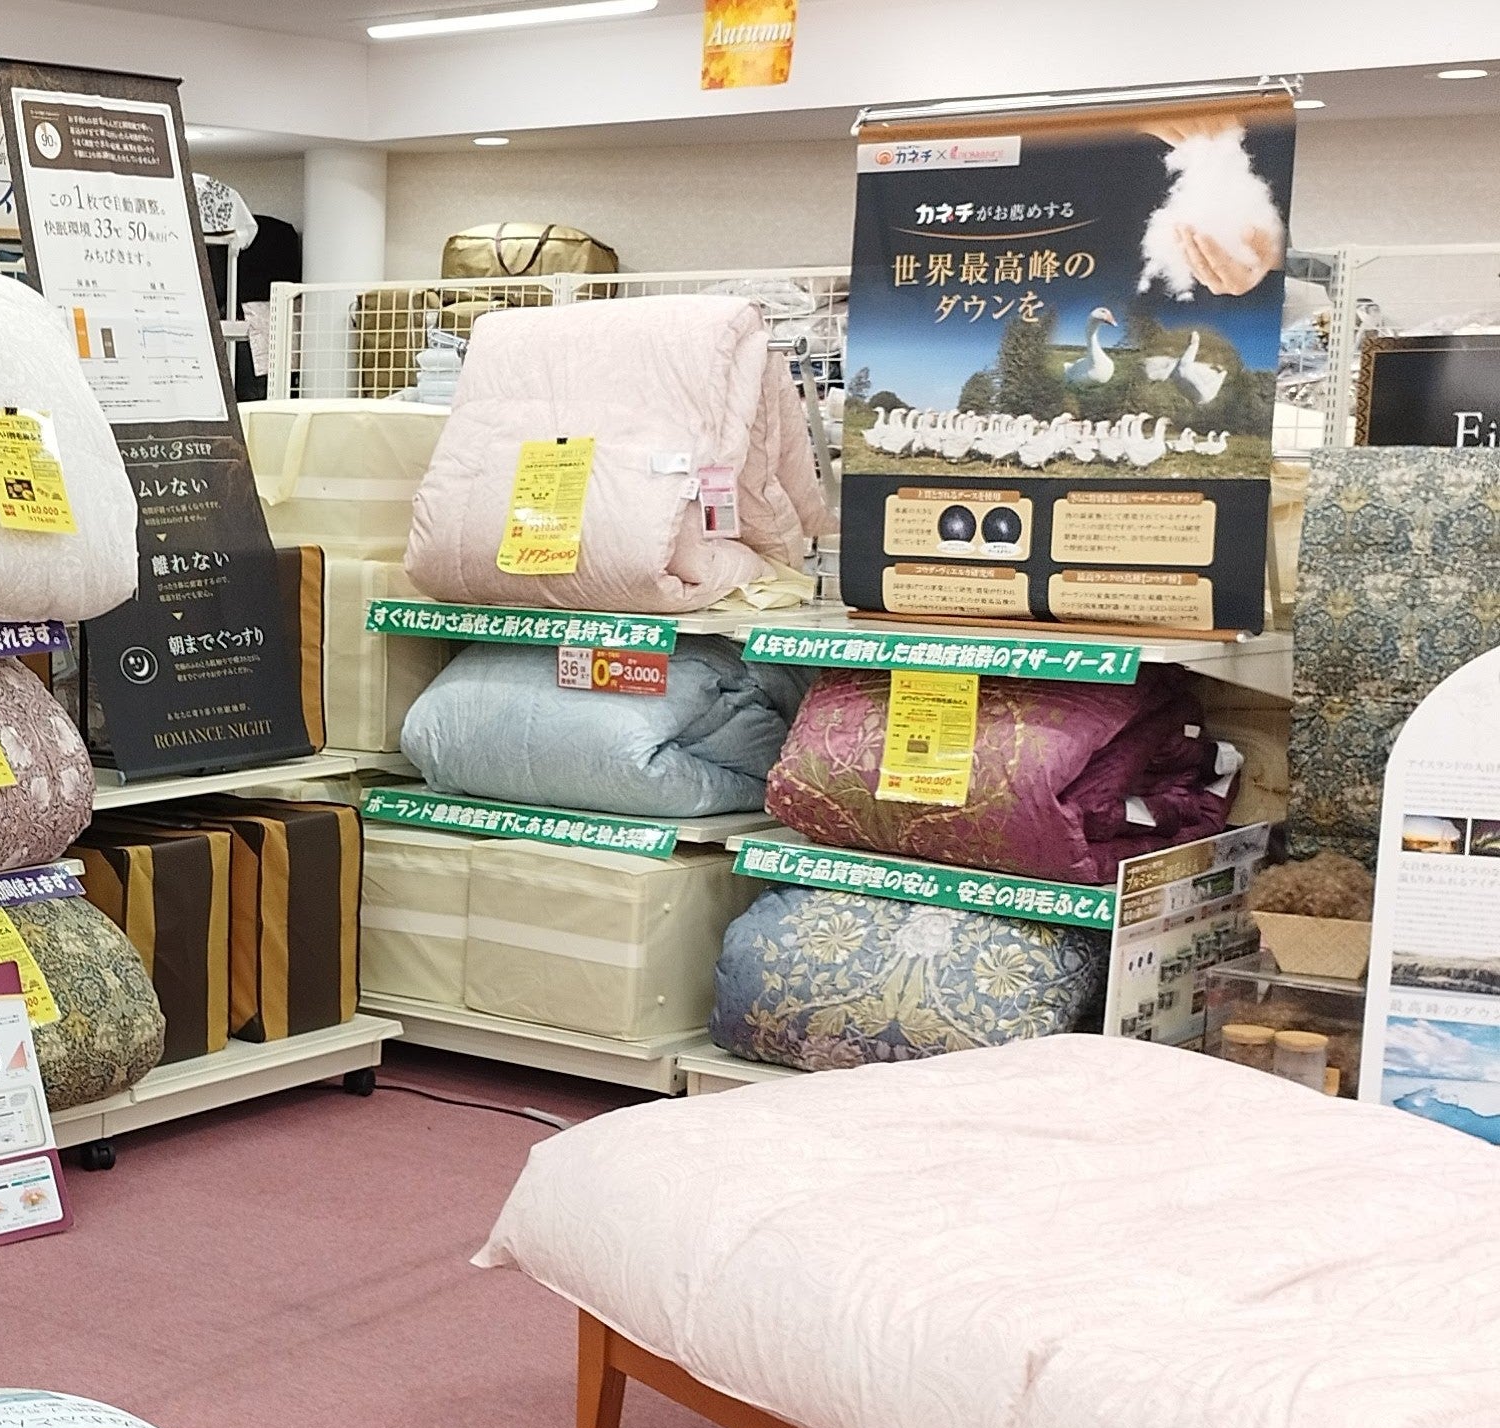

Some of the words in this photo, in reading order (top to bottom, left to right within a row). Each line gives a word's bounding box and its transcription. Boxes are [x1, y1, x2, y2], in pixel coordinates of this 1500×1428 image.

[708, 20, 792, 46] Autumn
[895, 149, 932, 164] カネチ
[915, 200, 1075, 225] カネチがお薦めする
[892, 249, 1096, 288] 世界最高峰の
[934, 290, 1045, 325] ダウンを
[185, 443, 212, 457] STEP
[138, 476, 209, 499] ムレない
[150, 550, 231, 578] 離れない
[167, 626, 266, 657] 朝までぐっすり
[372, 606, 668, 648] すぐれたかさ高性と耐久性で長持ちします。
[561, 660, 579, 677] 36
[592, 658, 610, 687] 0
[623, 665, 660, 683] 3,000
[153, 724, 227, 750] ROMANCE
[227, 718, 272, 740] NIGHT
[743, 846, 1113, 922] 徹底した品質管理の安心・安全の羽毛ふとん
